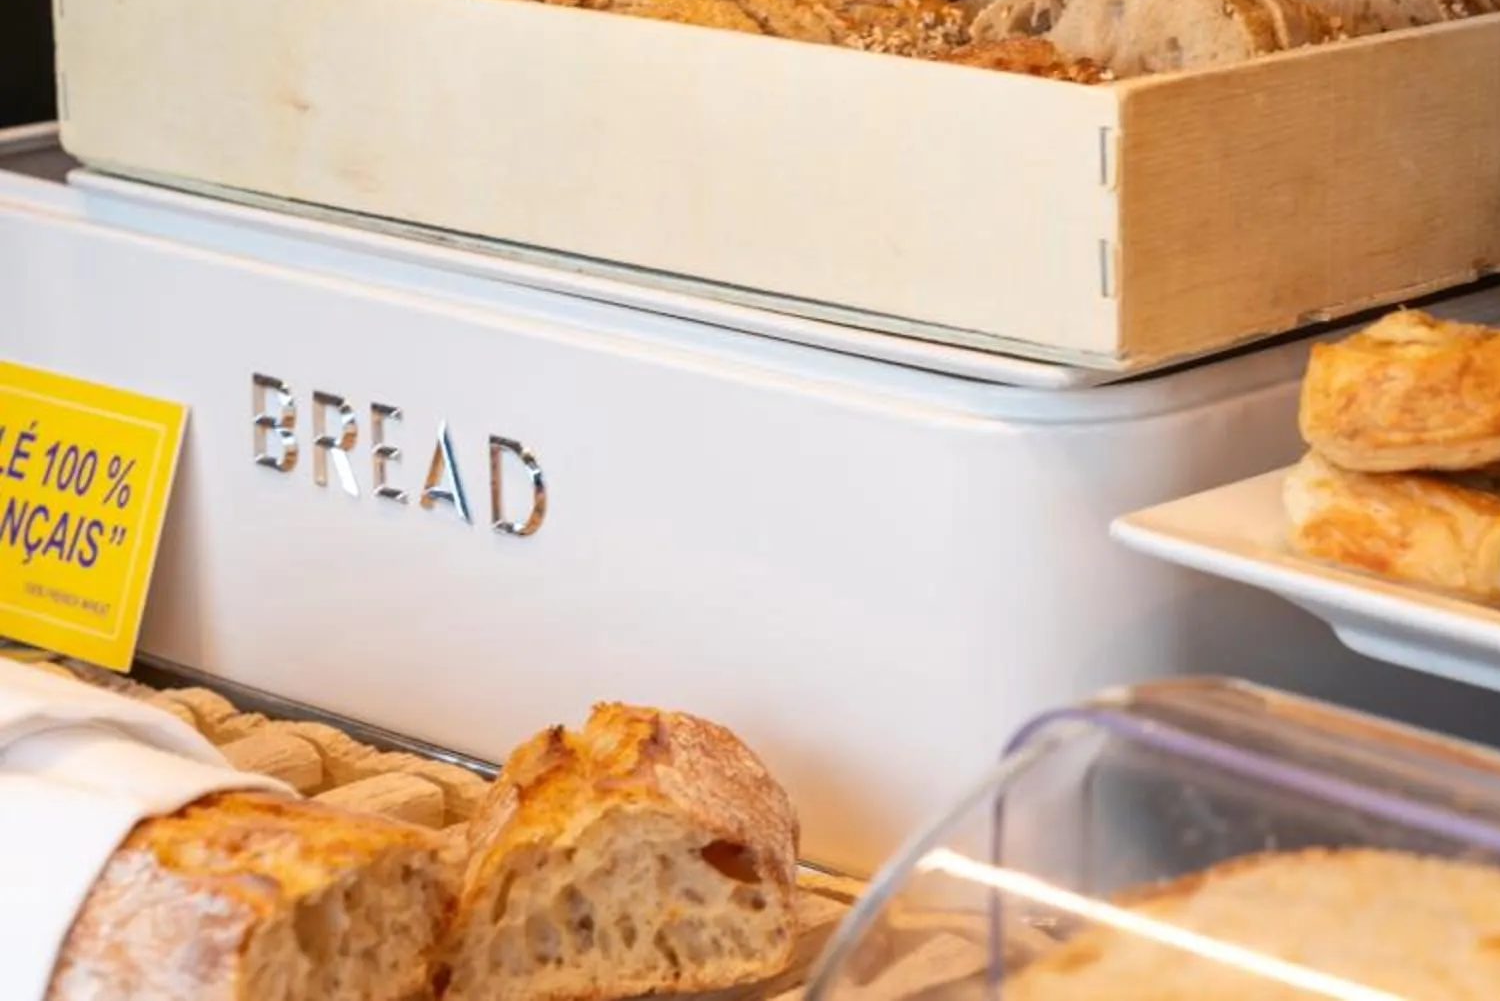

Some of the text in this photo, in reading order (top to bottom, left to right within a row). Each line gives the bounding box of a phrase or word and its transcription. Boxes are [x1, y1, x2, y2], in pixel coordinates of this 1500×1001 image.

[42, 441, 97, 496] 100
[103, 455, 136, 509] %
[252, 372, 547, 537] BREAD
